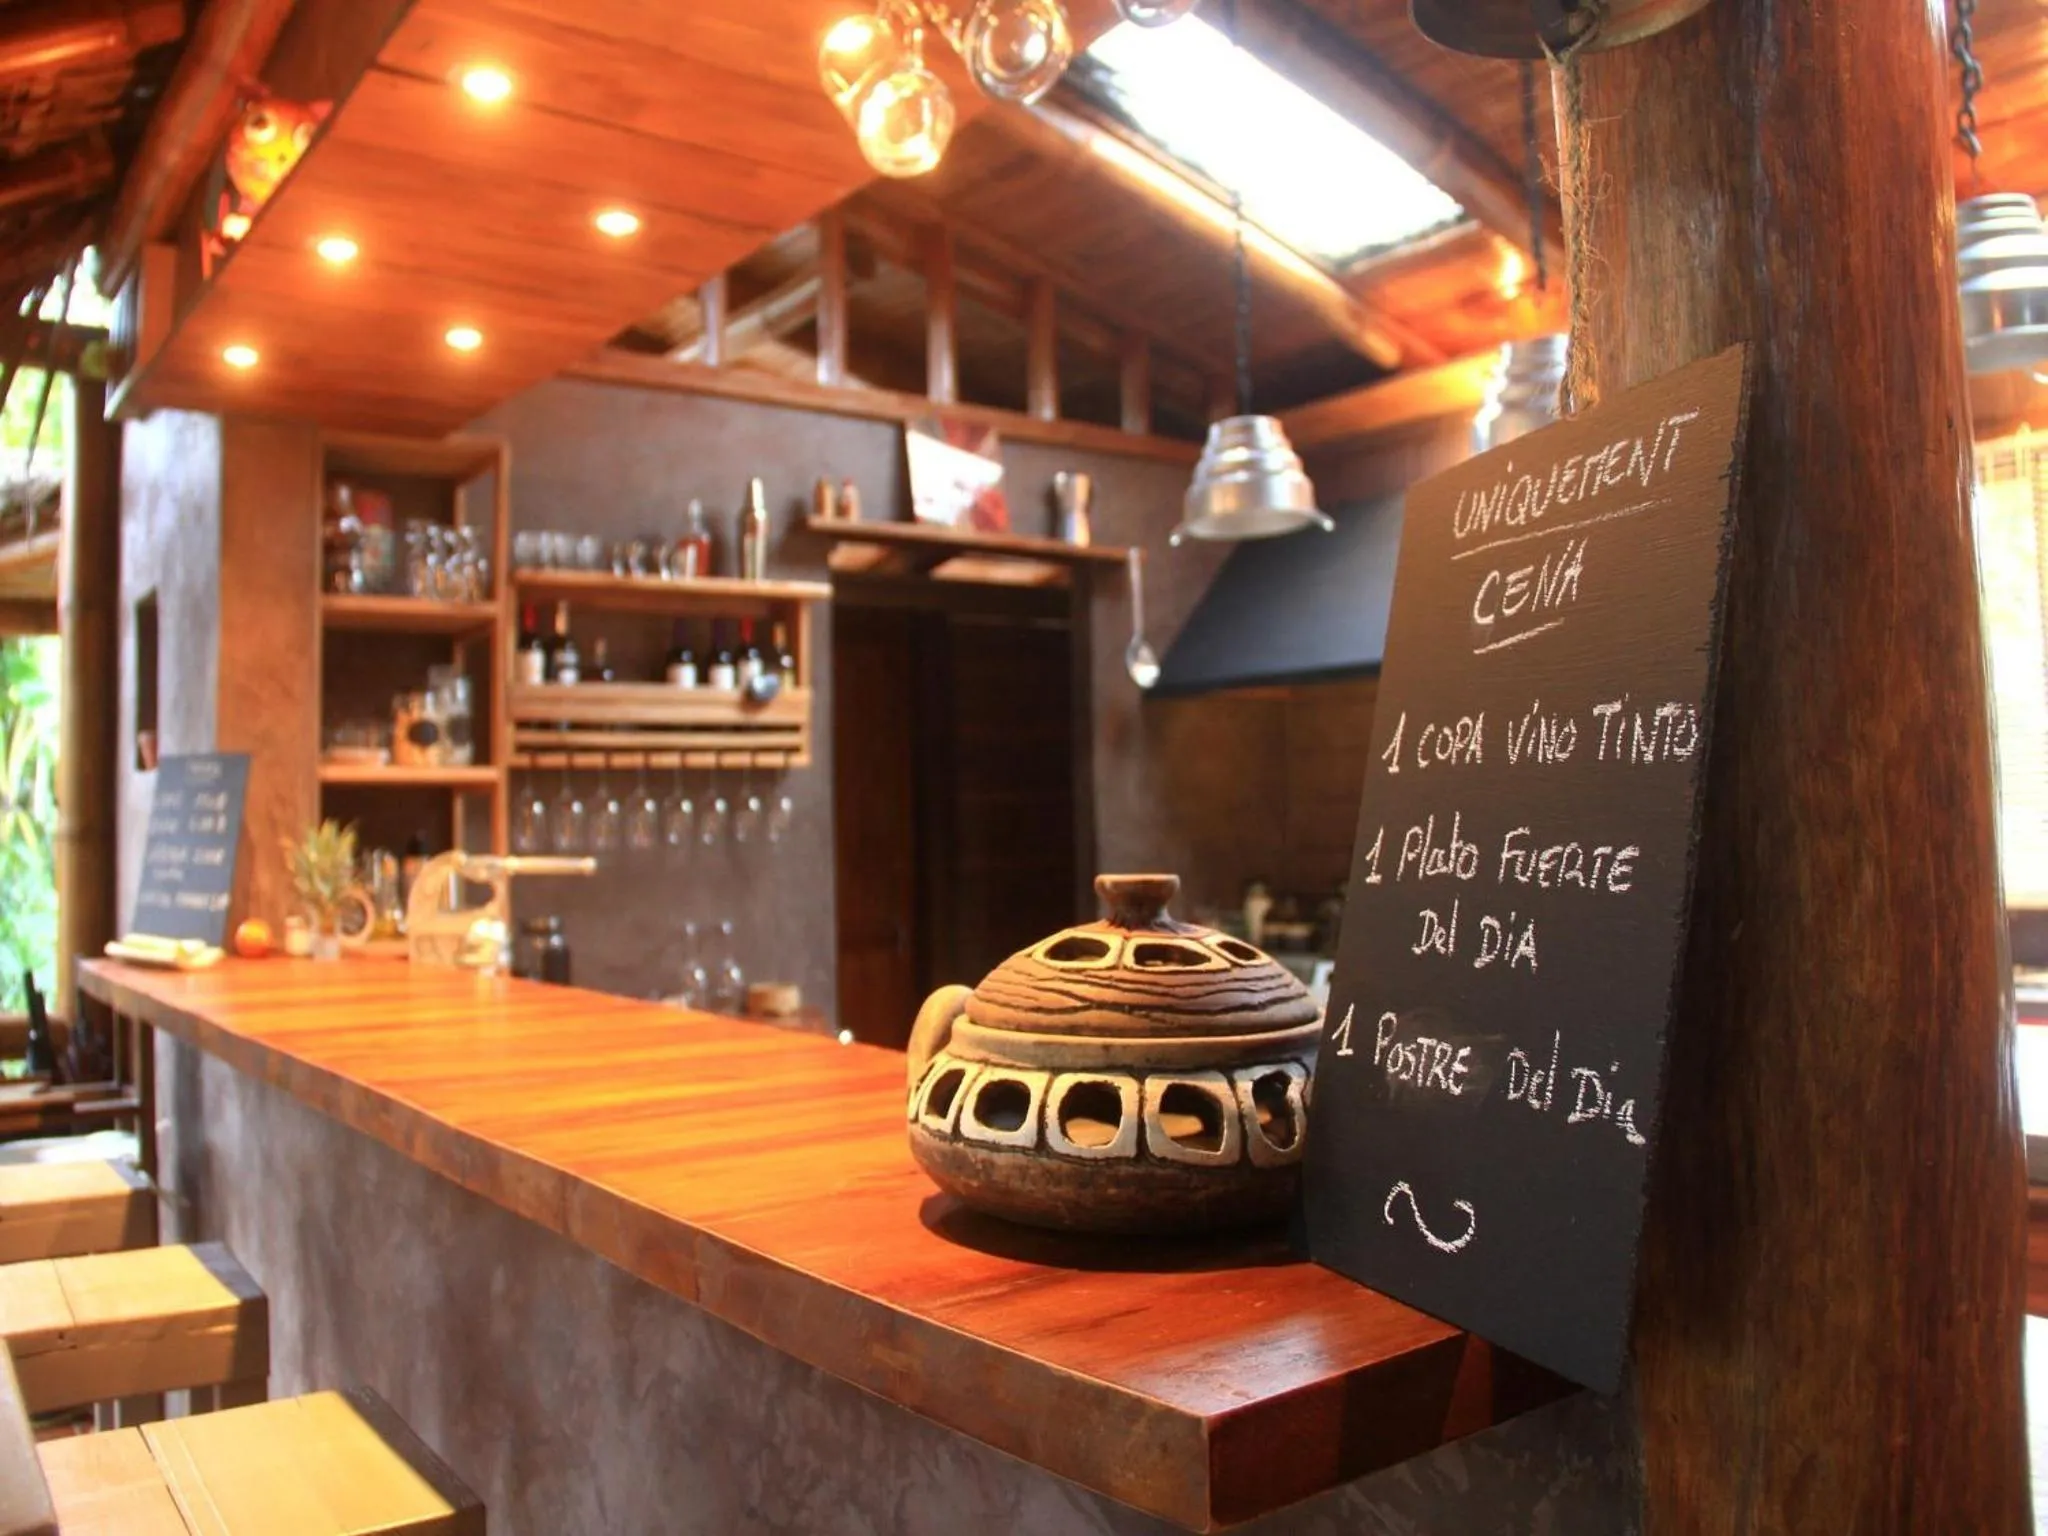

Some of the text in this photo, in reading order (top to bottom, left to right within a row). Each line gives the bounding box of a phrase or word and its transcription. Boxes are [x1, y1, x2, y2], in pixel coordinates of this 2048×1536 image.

[1473, 537, 1589, 625] CENA
[1382, 711, 1407, 774] 1
[1417, 711, 1485, 768] COPA
[1365, 811, 1641, 893] 1 Plato FUERTE
[1411, 894, 1460, 957] Del
[1331, 1002, 1356, 1057] 1
[1506, 1028, 1562, 1112] Del
